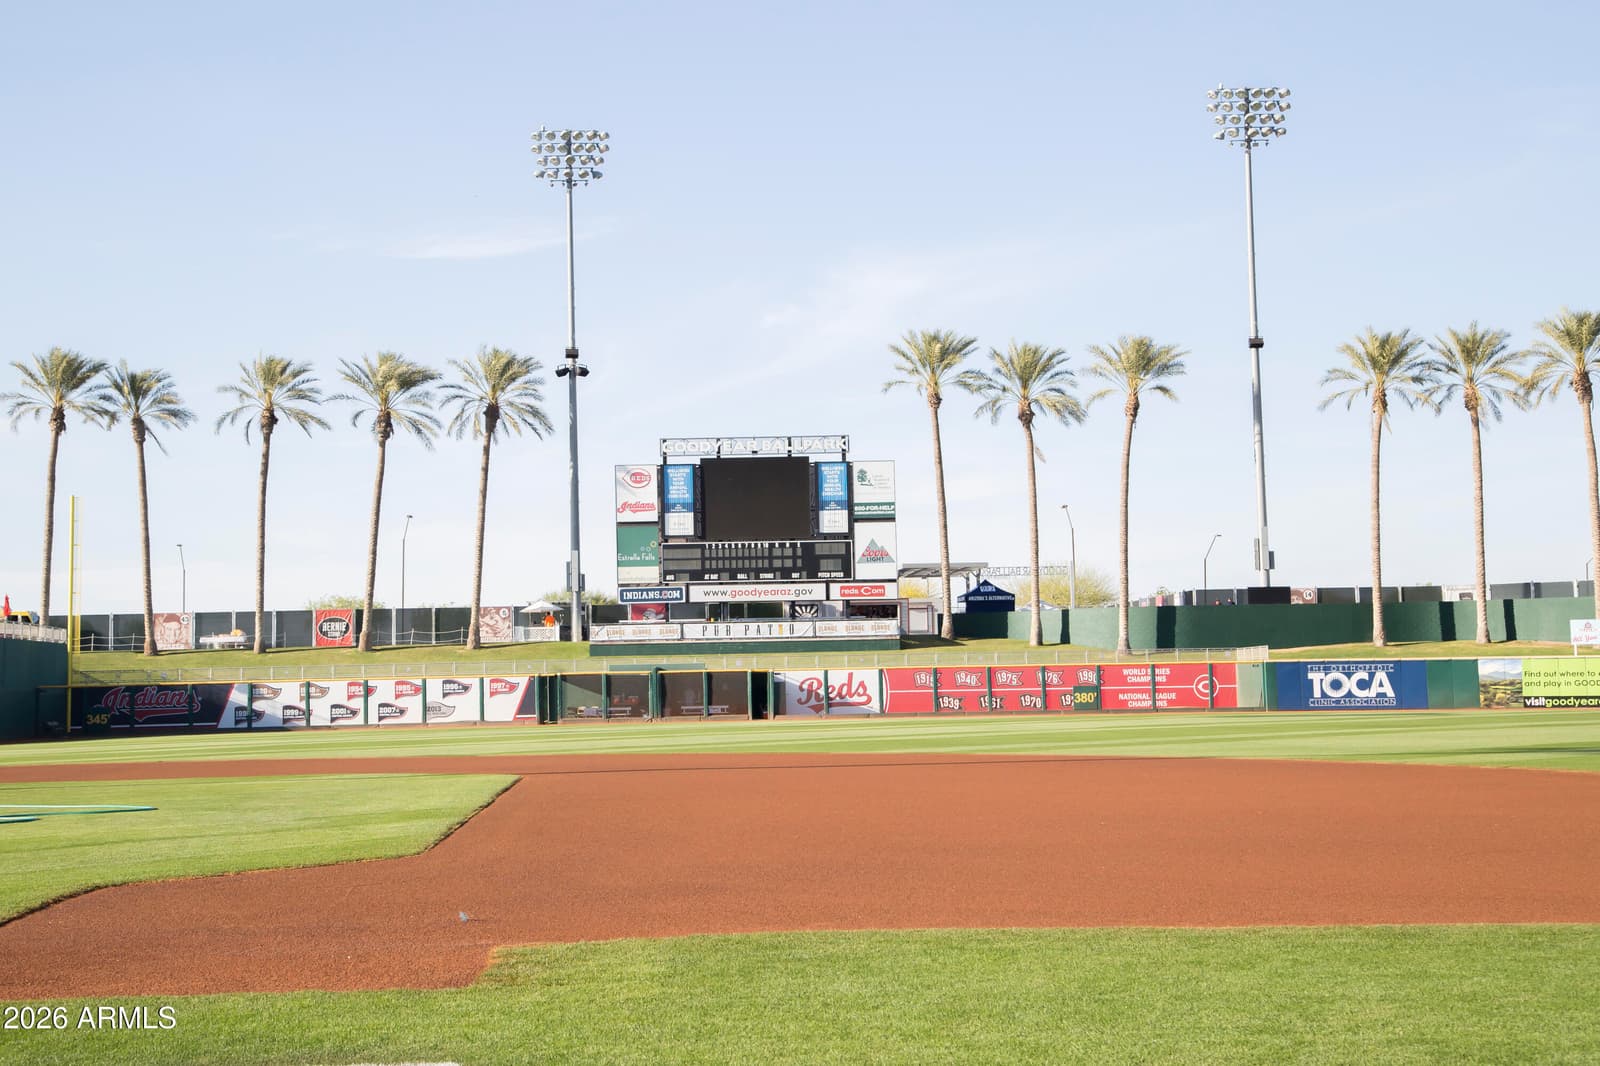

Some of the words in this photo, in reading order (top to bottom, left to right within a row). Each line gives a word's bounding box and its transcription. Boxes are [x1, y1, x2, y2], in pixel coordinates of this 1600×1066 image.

[662, 440, 758, 454] GOODYEAR
[762, 438, 848, 452] BALLPARK
[618, 501, 656, 514] Indians
[618, 553, 640, 561] Estrella
[641, 552, 655, 561] Falls
[862, 546, 889, 557] Coors
[623, 590, 680, 599] INDIANS.COM
[703, 586, 813, 598] www.goodyearaz.gov
[702, 625, 731, 636] PUB
[745, 624, 794, 636] PATIO
[956, 672, 976, 684] 1940
[997, 672, 1017, 684] 1975
[1544, 680, 1561, 688] play
[796, 672, 872, 706] Reds
[1308, 671, 1395, 698] TOCA
[102, 686, 201, 712] Indians
[939, 696, 960, 709] 1939
[1021, 695, 1041, 707] 1970
[1074, 693, 1096, 703] 380'
[86, 713, 110, 724] 345'
